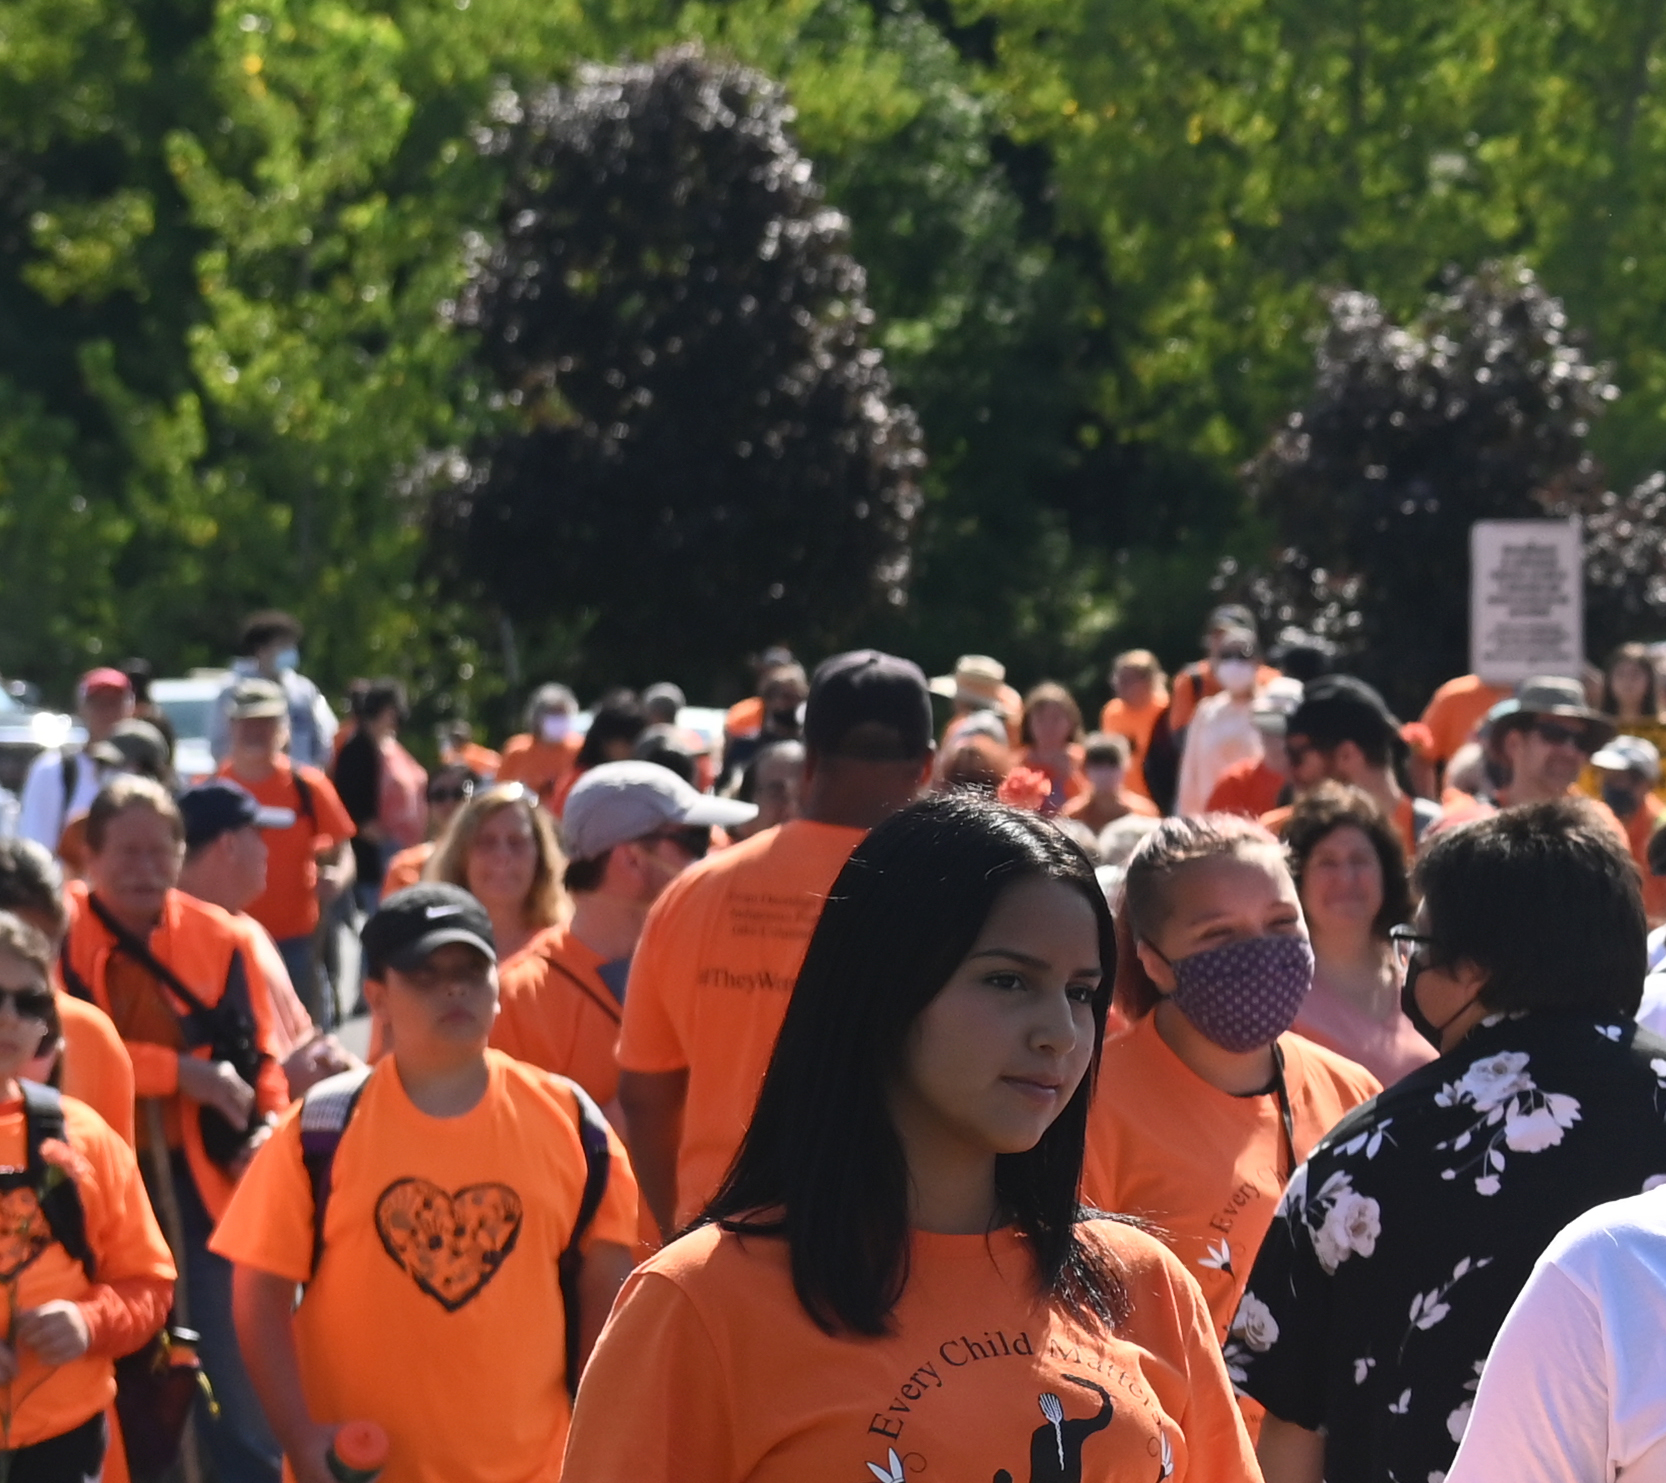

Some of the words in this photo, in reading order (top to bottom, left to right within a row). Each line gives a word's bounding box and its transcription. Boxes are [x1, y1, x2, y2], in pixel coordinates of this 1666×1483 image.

[1209, 1181, 1261, 1235] Every
[867, 1361, 943, 1441] Every
[939, 1331, 1035, 1367] Child
[1050, 1338, 1162, 1426] Matters
